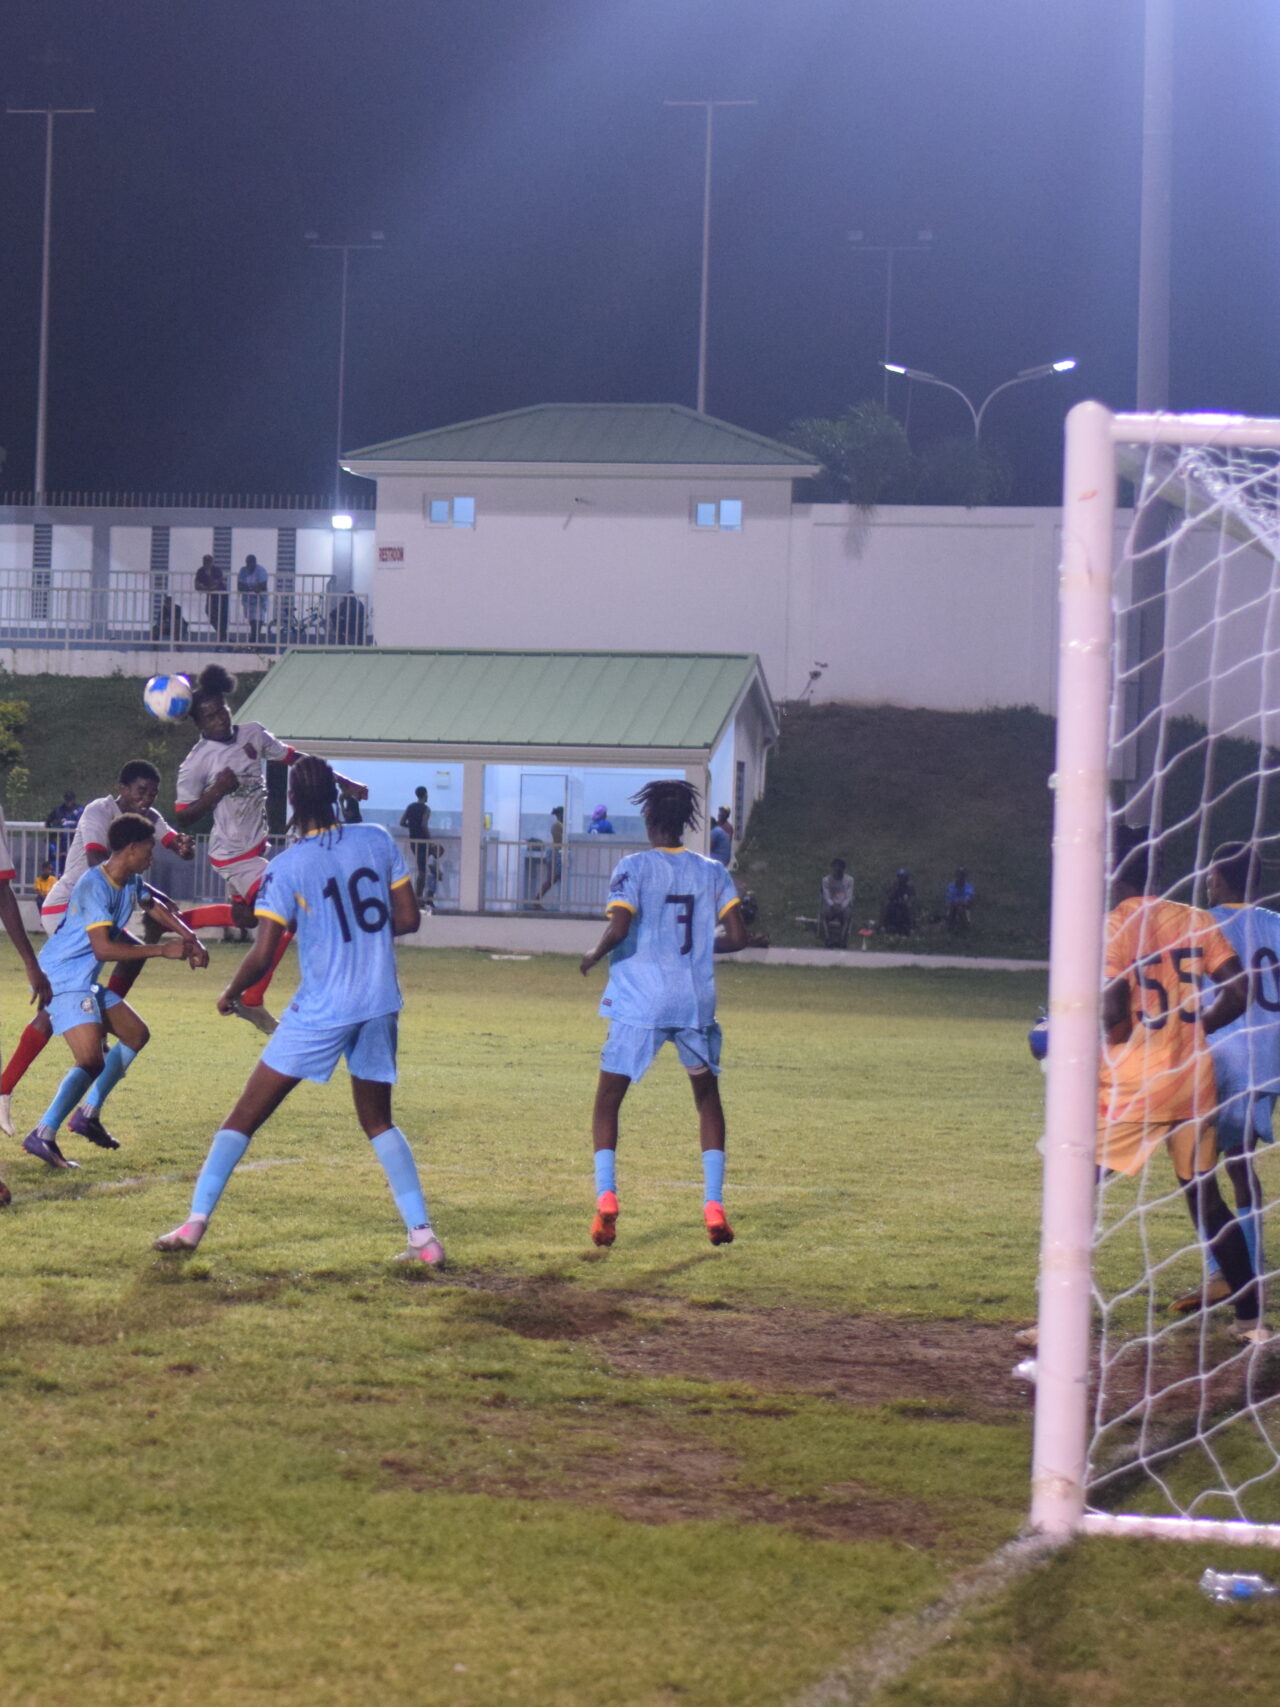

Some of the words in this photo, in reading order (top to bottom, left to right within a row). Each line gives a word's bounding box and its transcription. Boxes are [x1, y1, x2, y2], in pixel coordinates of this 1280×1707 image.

[322, 867, 388, 943] 16
[665, 894, 695, 956] 7
[1132, 947, 1204, 1030] 55
